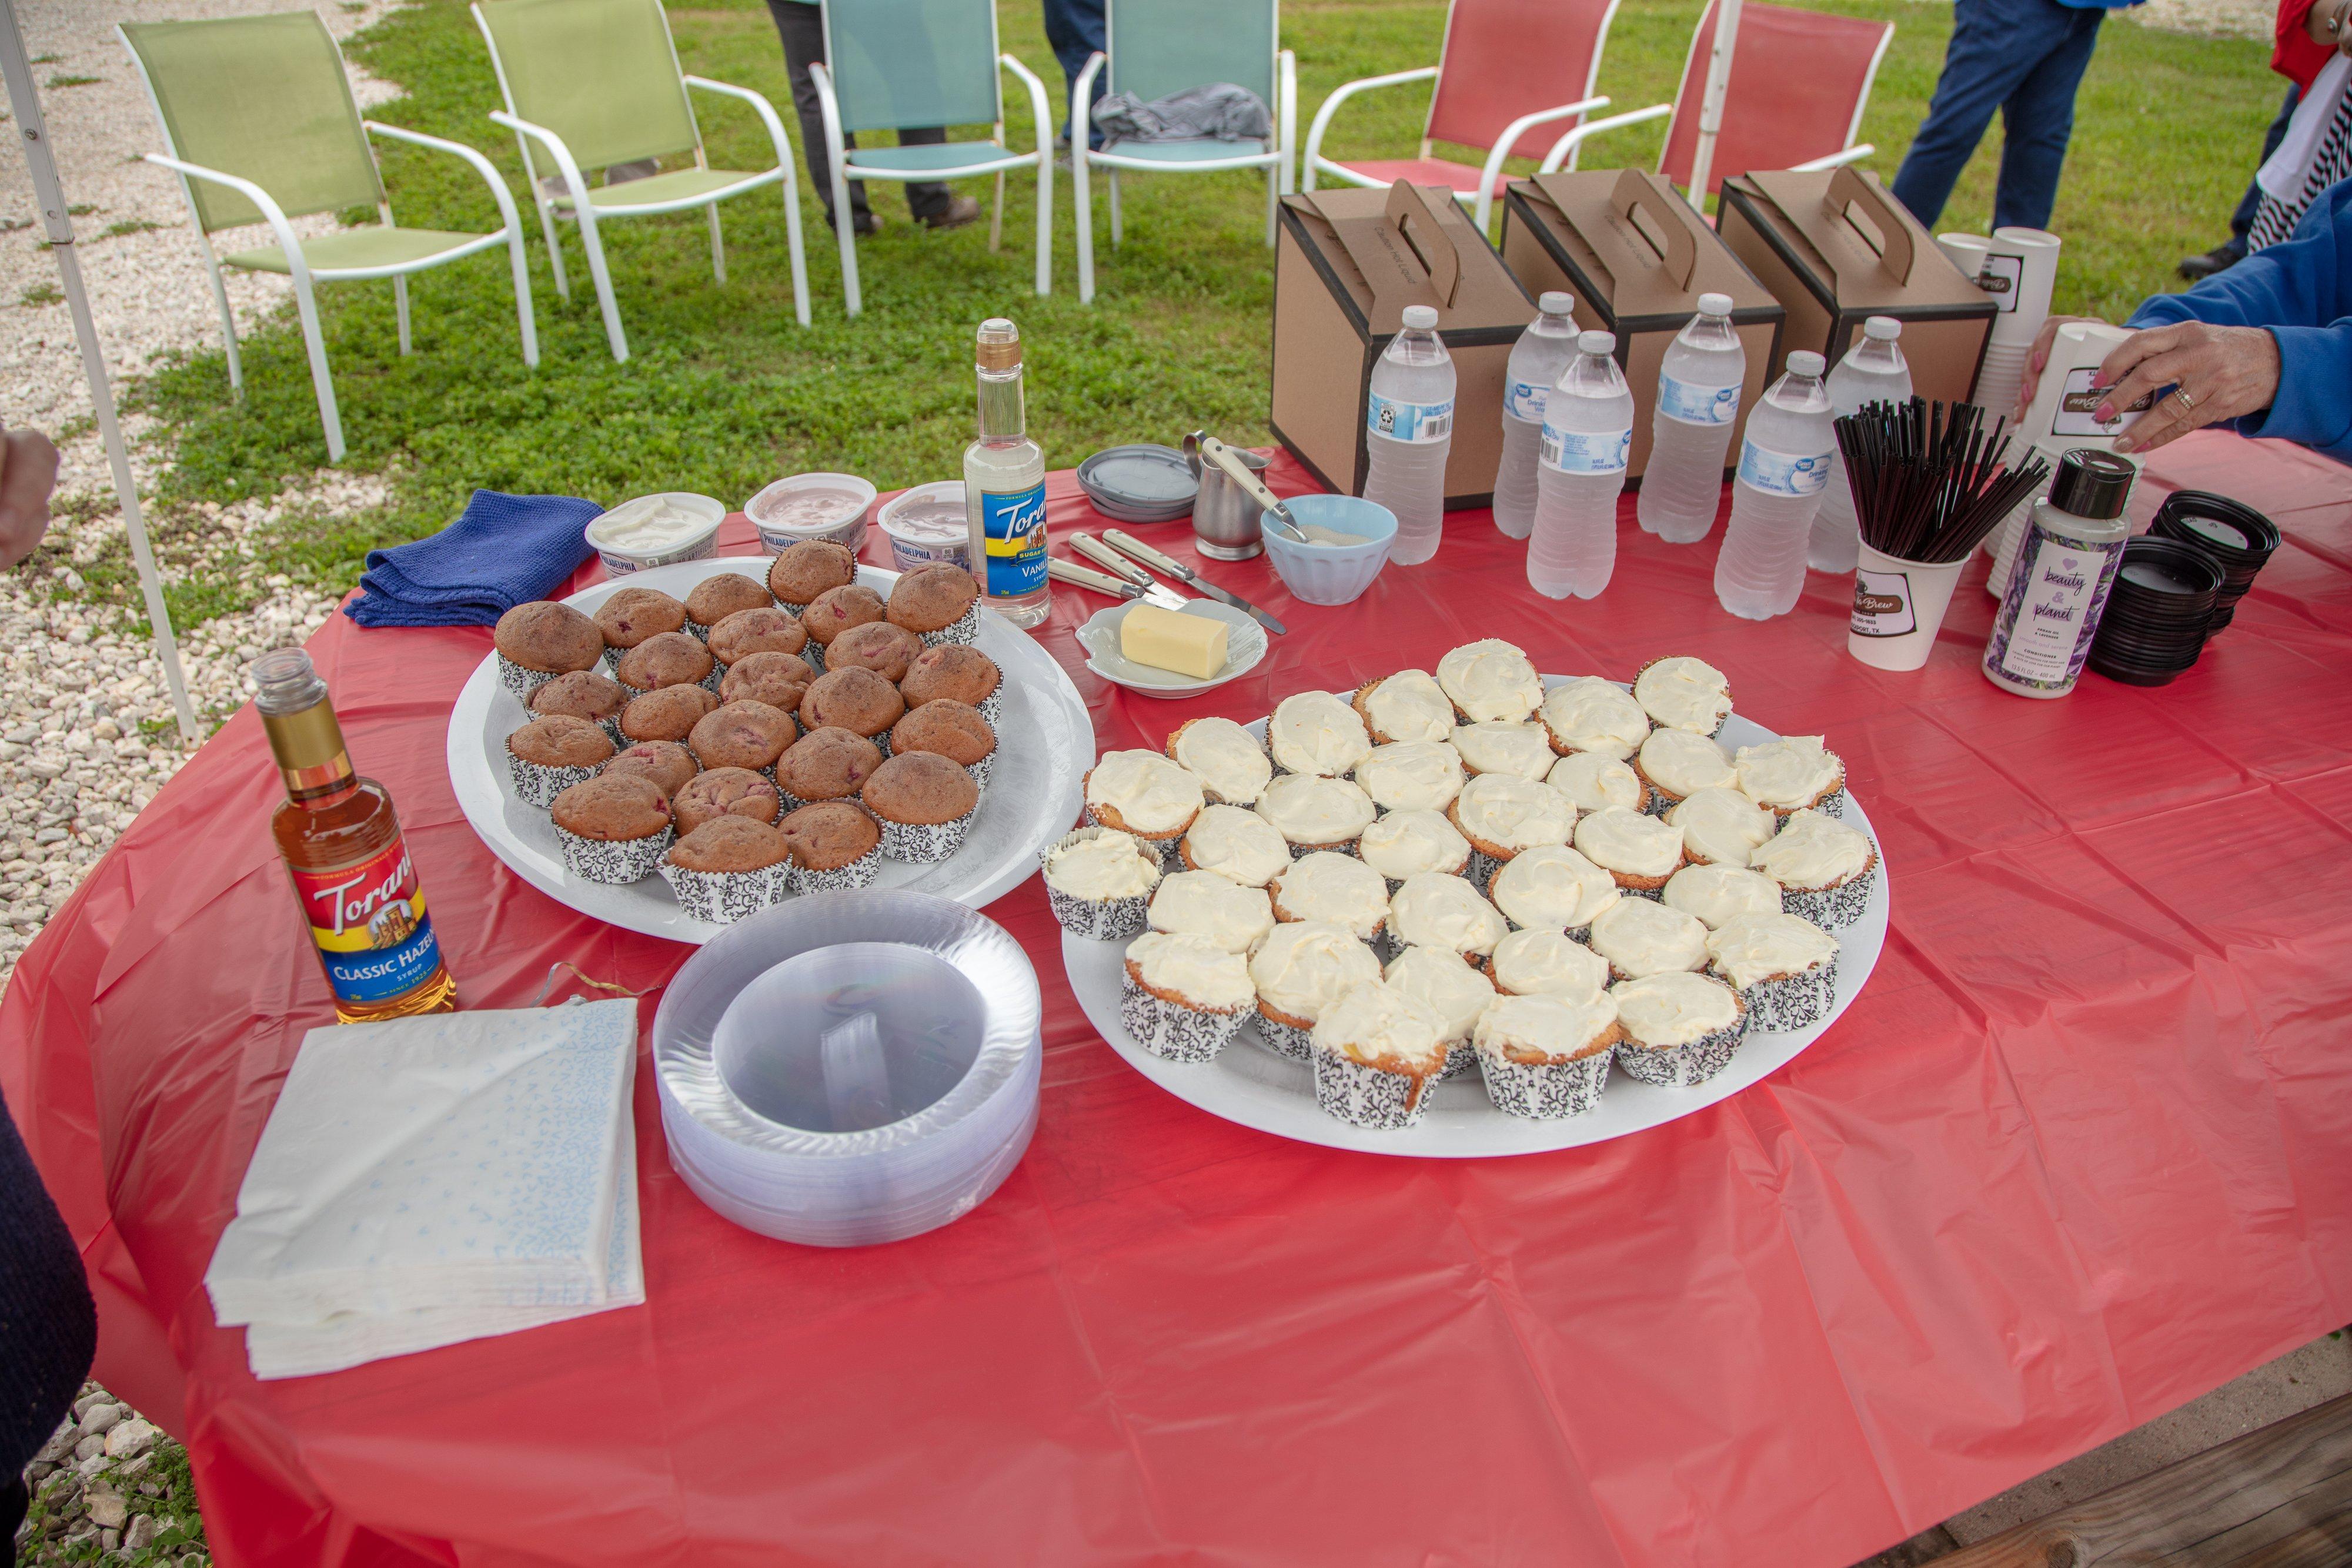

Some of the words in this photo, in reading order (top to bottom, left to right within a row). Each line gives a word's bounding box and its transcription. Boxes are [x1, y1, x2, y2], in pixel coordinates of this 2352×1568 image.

[1374, 226, 1394, 252] Caution
[1389, 250, 1403, 264] Hot
[1398, 262, 1418, 285] Liquid
[1528, 399, 1545, 407] Drinki
[763, 534, 806, 548] PHILADELP
[892, 540, 931, 560] PHILADELPHIA
[1019, 549, 1040, 559] SUGAR
[2044, 566, 2086, 596] beauty
[1863, 597, 1893, 609] Brew
[2052, 591, 2064, 604] &
[2033, 602, 2080, 622] planet
[2019, 635, 2037, 646] smooth
[2024, 648, 2057, 659] CONDITIONER
[320, 870, 355, 880] FORMULA
[355, 852, 389, 873] ORIGINALE
[333, 959, 397, 981] CLASSIC
[396, 963, 423, 982] SYRUP
[389, 983, 410, 994] SINCE
[411, 971, 428, 985] 1925
